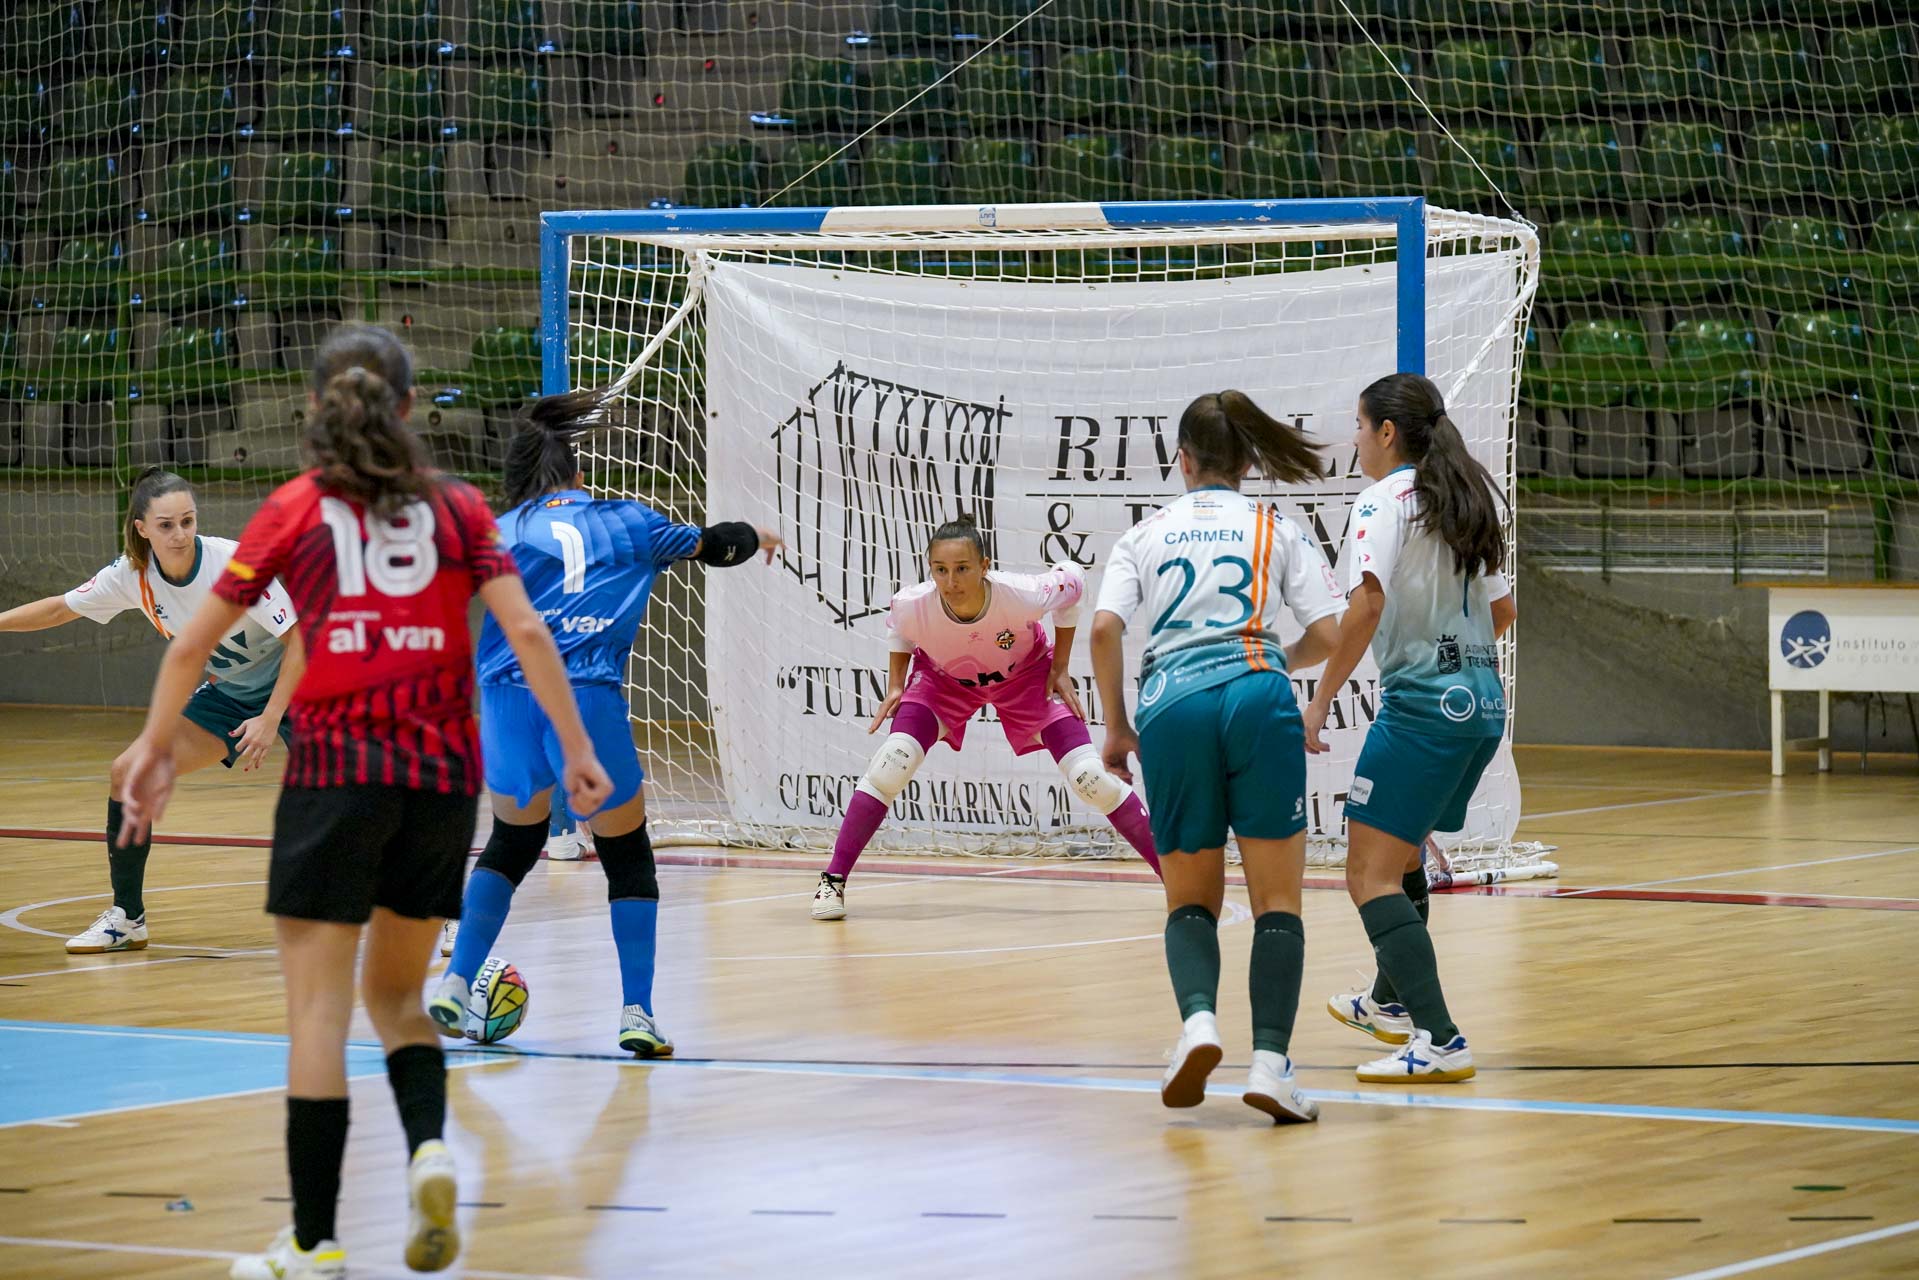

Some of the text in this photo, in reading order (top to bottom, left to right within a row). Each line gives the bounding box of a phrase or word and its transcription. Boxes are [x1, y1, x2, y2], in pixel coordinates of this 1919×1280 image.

[320, 496, 439, 597] 18
[550, 521, 586, 594] 1
[1040, 502, 1096, 570] &
[1165, 530, 1245, 545] CARMEN
[1152, 555, 1254, 637] 23
[1048, 786, 1072, 826] 20
